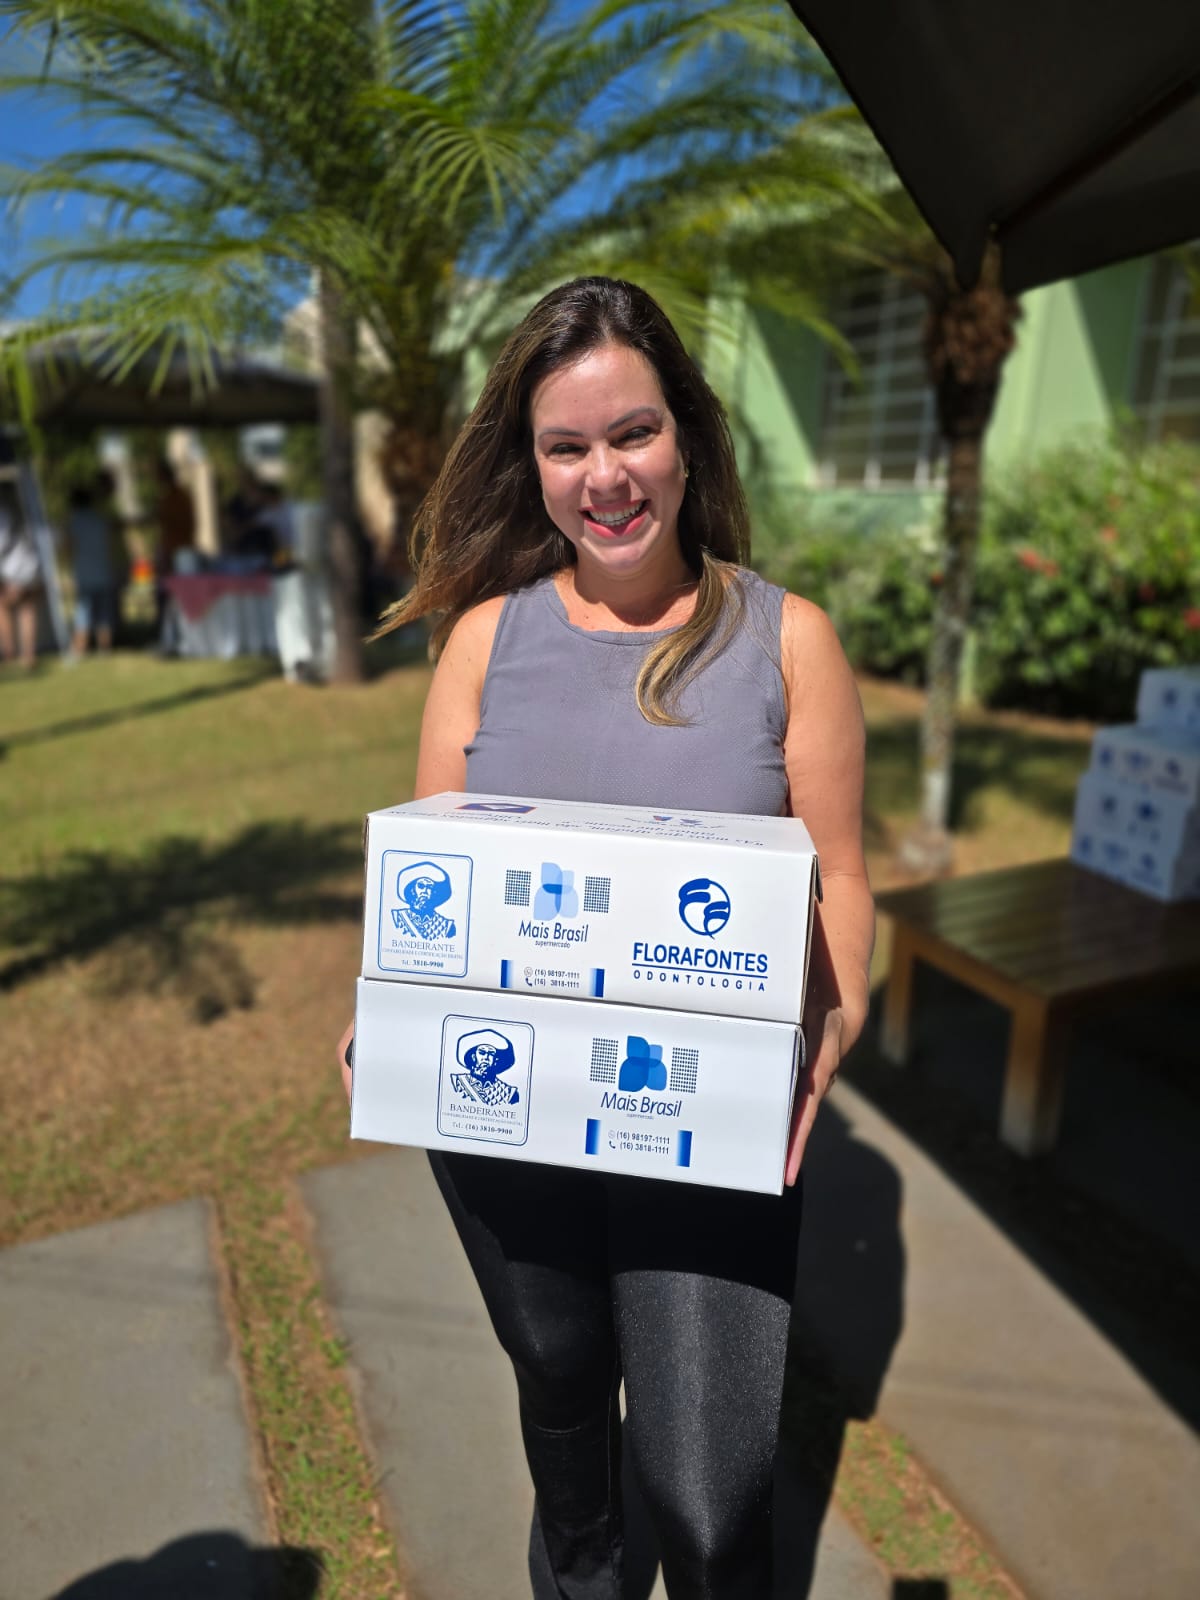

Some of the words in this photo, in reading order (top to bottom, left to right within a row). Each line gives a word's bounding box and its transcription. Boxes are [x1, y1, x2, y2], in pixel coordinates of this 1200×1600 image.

[518, 920, 549, 939] Mais
[553, 922, 589, 942] Brasil
[391, 939, 456, 952] BANDEIRANTE
[535, 940, 571, 948] supermercado
[633, 942, 768, 973] FLORAFONTES
[534, 969, 547, 977] (16)
[547, 969, 580, 979] 98197-1111
[633, 969, 765, 992] ODONTOLOGIA
[534, 978, 546, 987] (16)
[550, 979, 580, 988] 3818-1111
[450, 1103, 517, 1119] BANDEIRANTE
[600, 1091, 638, 1112] Mais
[640, 1096, 682, 1117] Brasil
[465, 1123, 478, 1131] (16)
[616, 1130, 630, 1140] (16)
[631, 1132, 670, 1145] 98197-1111
[620, 1141, 634, 1151] (16)
[635, 1142, 669, 1154] 3818-1111
